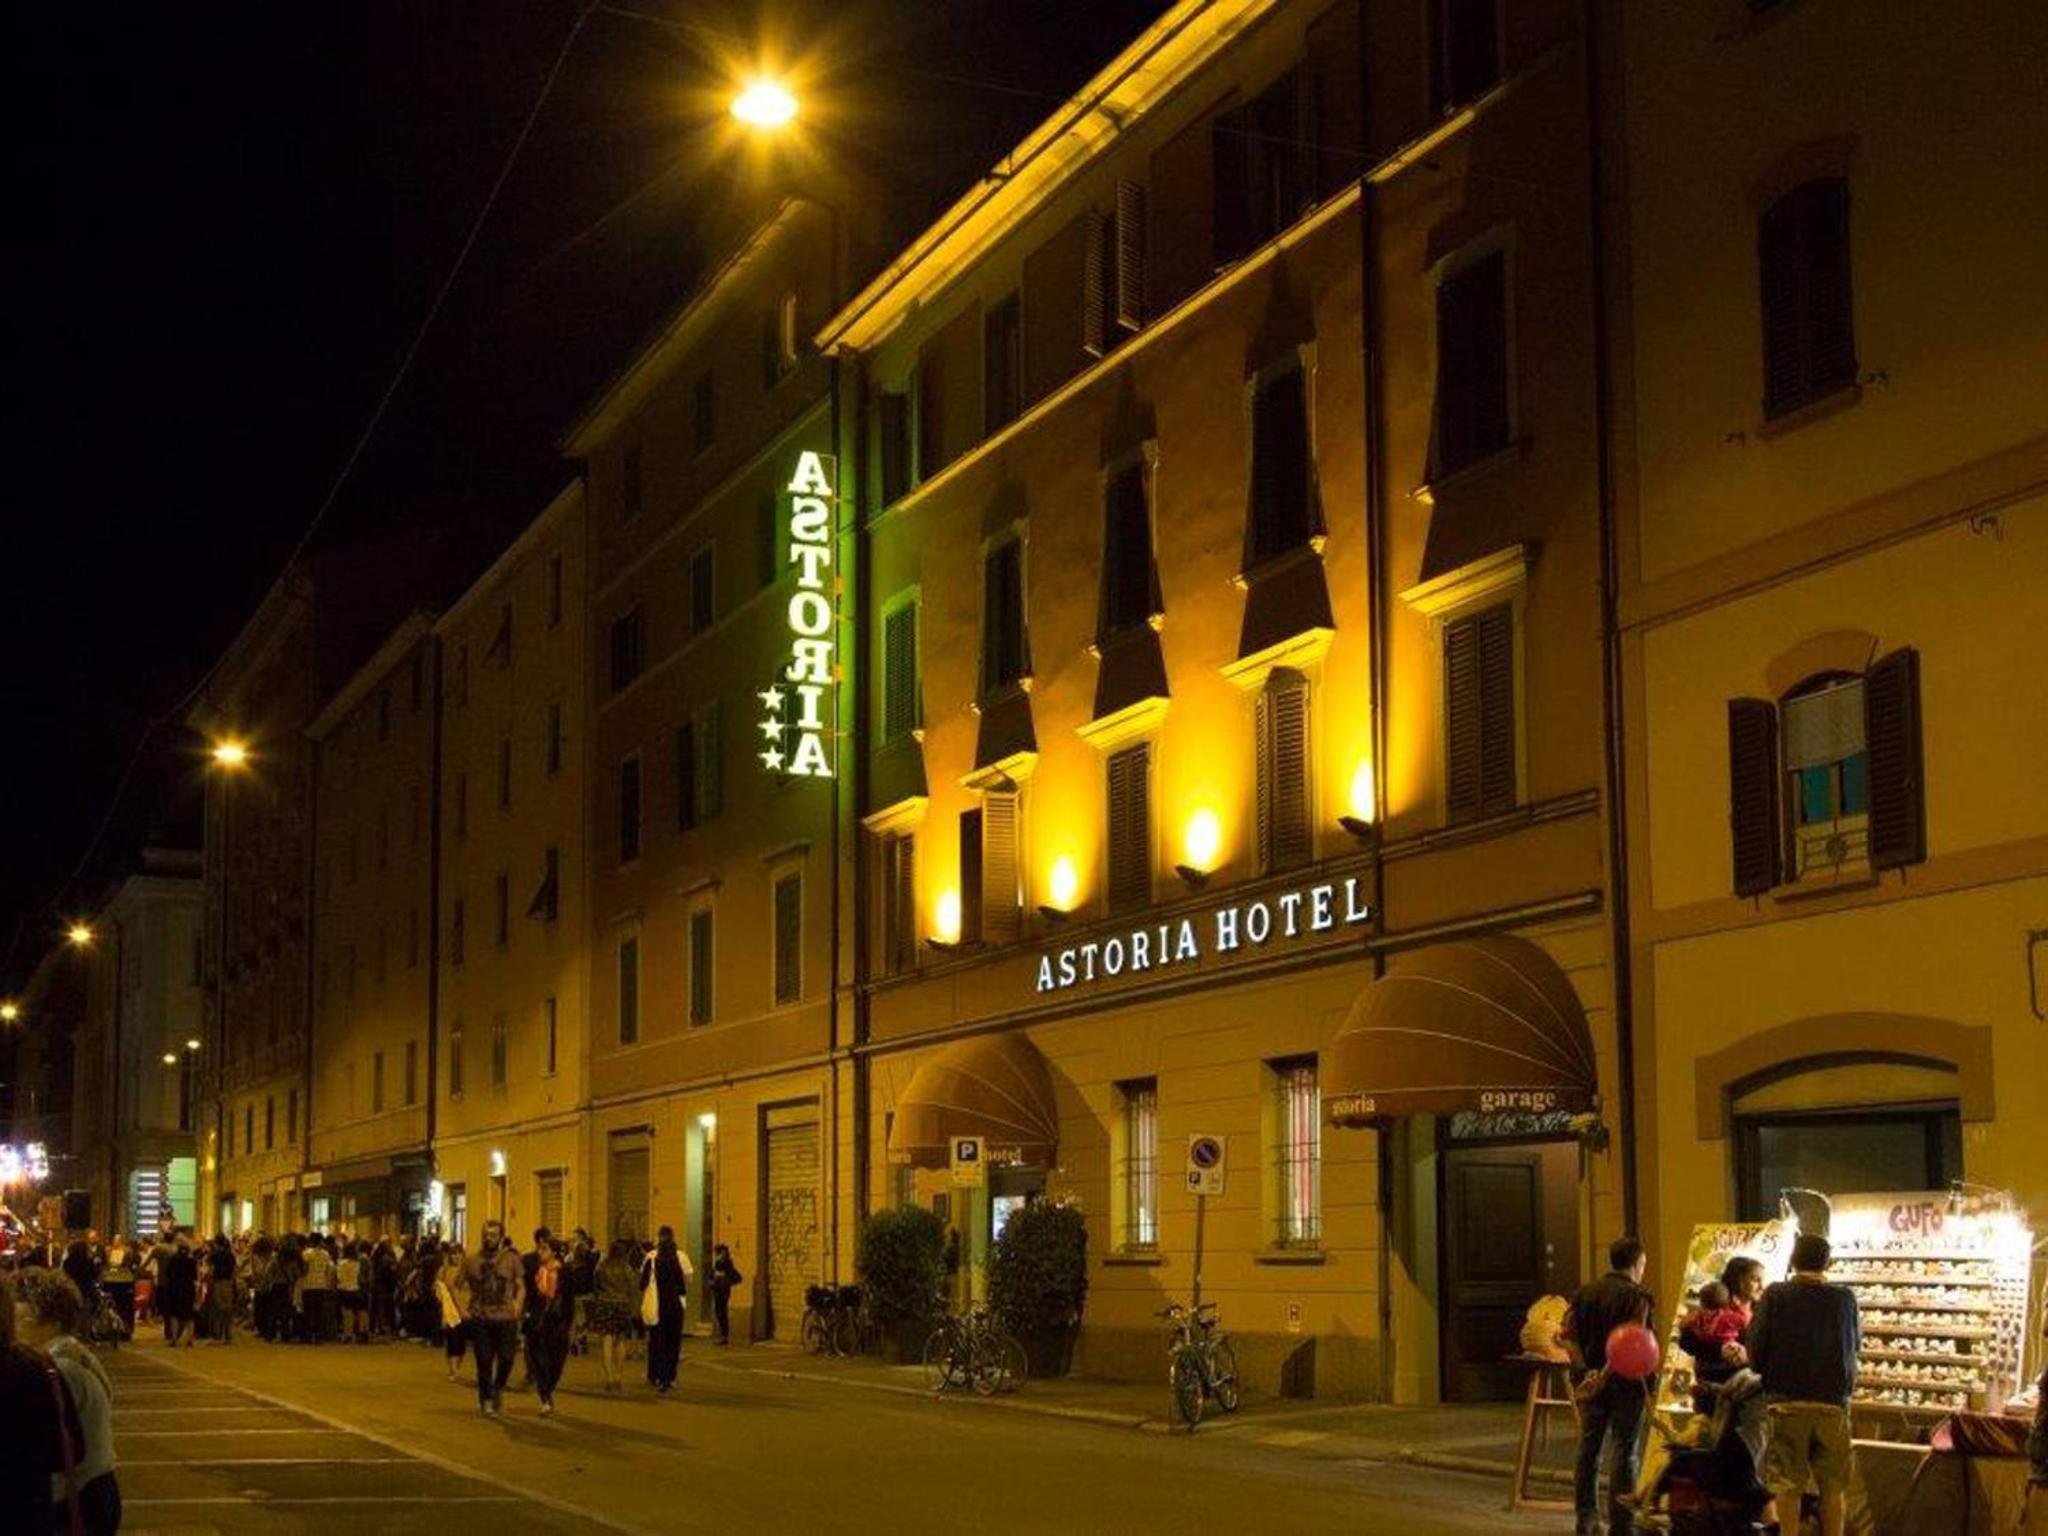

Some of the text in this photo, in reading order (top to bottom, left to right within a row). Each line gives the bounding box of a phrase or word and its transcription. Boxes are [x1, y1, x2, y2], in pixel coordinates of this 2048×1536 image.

[1036, 876, 1370, 993] ASTORIA HOTEL
[1479, 1090, 1556, 1112] garage
[961, 1143, 975, 1159] P
